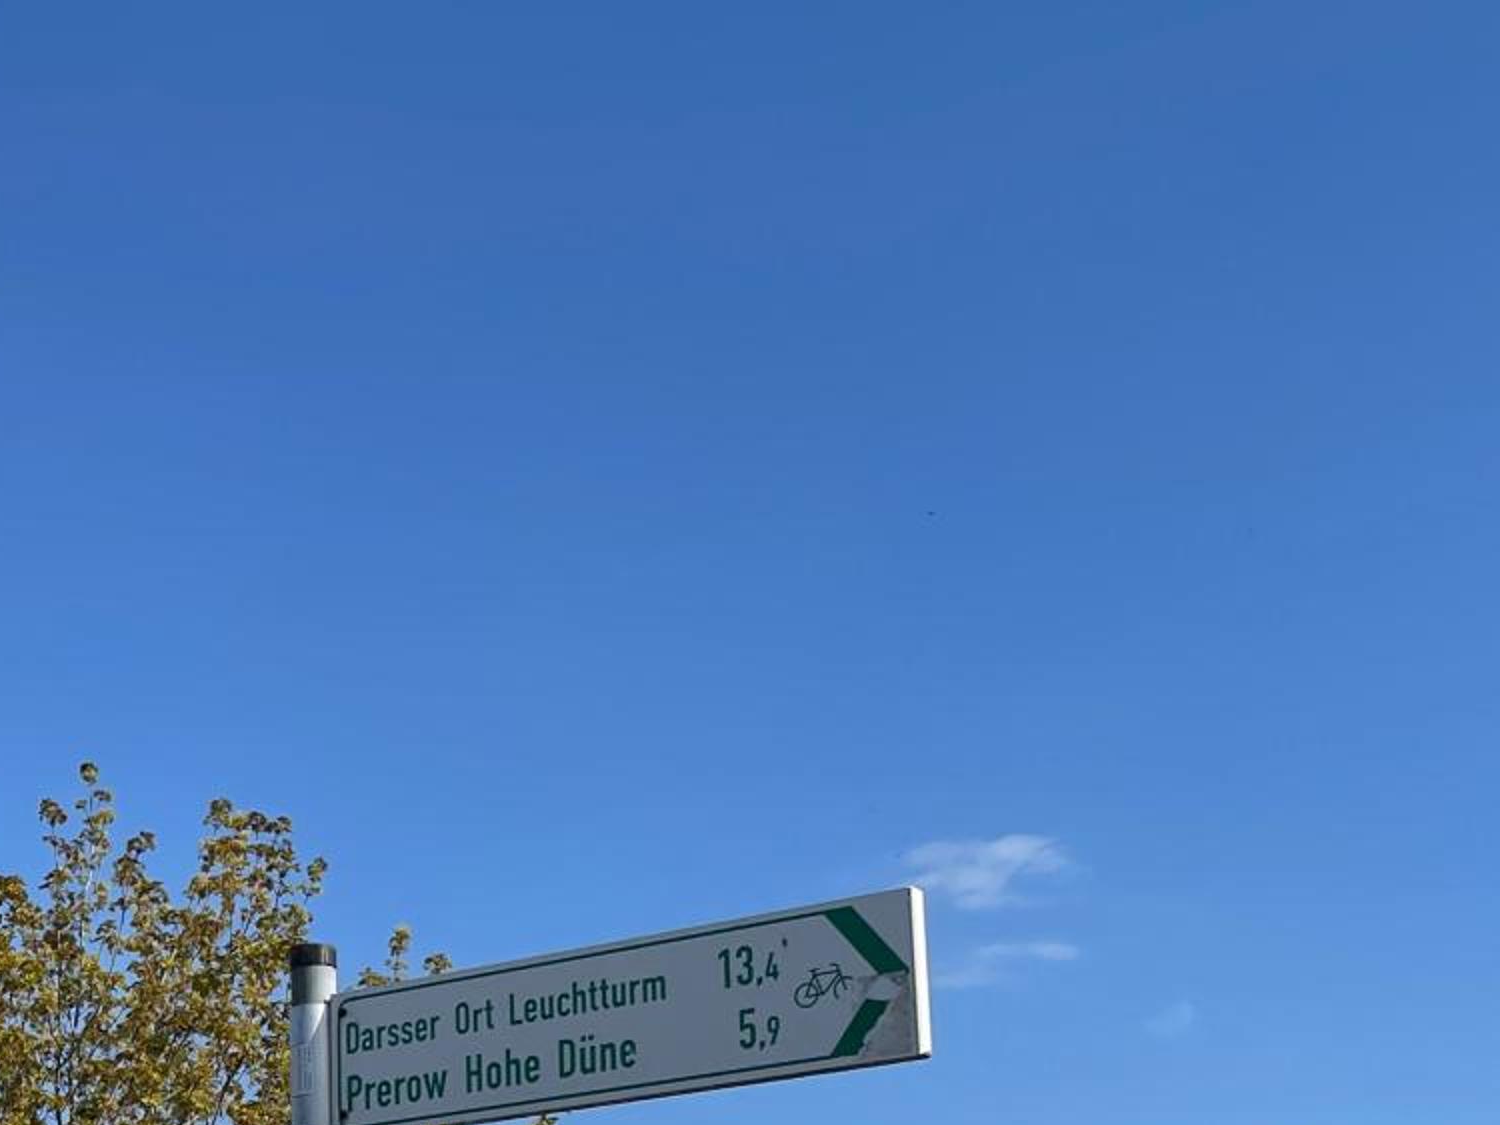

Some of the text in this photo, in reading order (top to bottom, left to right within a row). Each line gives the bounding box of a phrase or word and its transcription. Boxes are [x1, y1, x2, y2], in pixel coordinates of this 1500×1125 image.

[345, 946, 780, 1055] Darsser Ort Leuchtturm 13,4
[346, 1067, 447, 1113] Prerow
[465, 1046, 541, 1093] Hohe
[558, 1037, 637, 1079] Düne
[739, 1008, 780, 1052] 5,9
